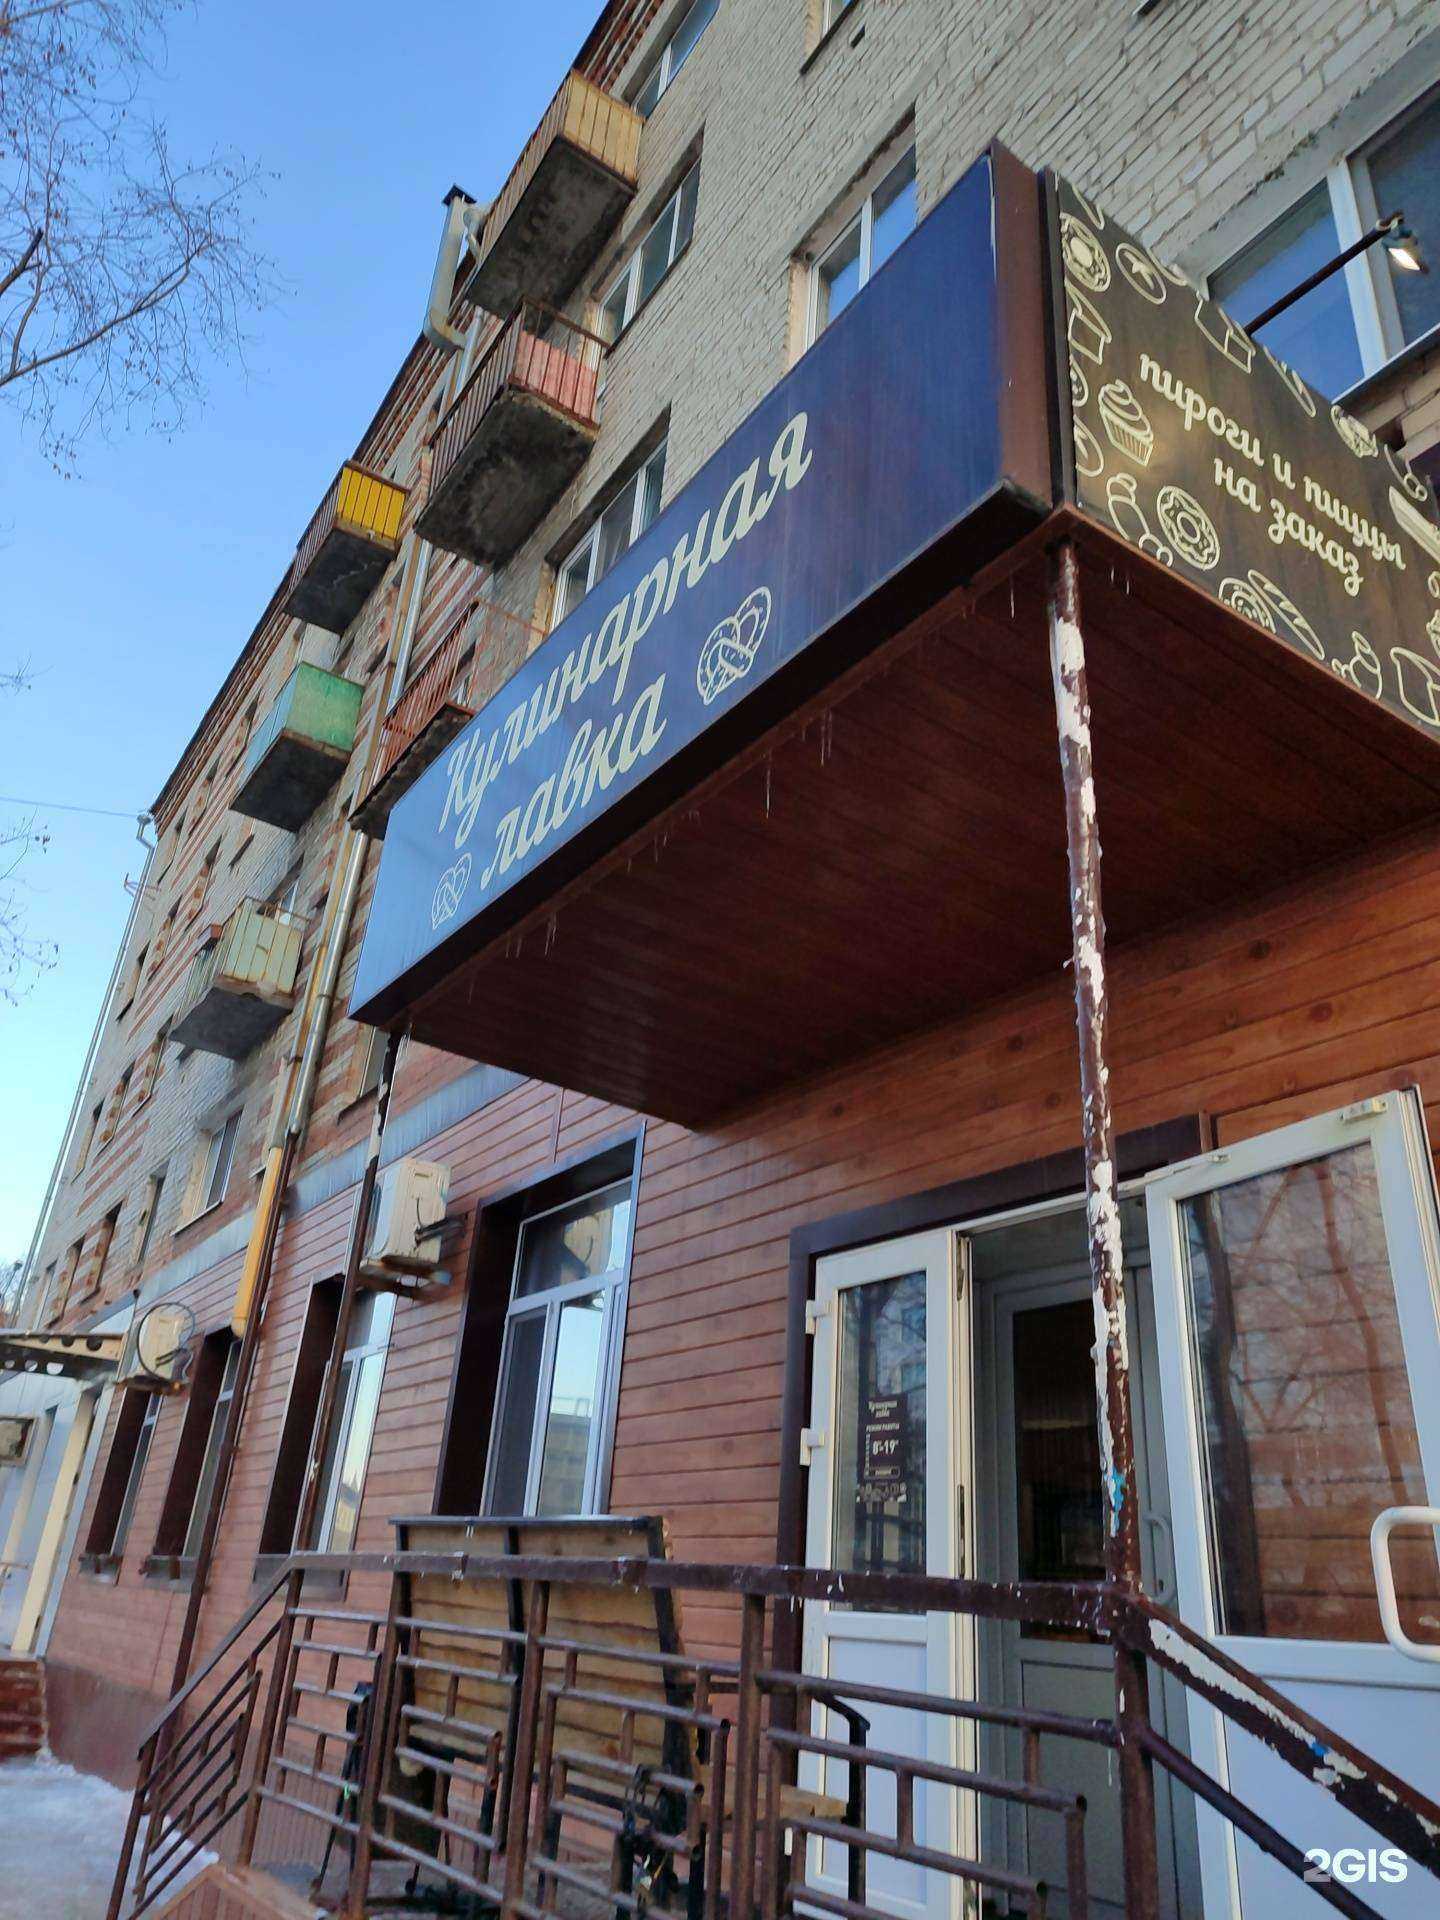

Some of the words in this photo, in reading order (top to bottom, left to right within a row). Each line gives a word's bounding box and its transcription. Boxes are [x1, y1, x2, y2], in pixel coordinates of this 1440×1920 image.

[1139, 353, 1265, 467] пироги
[1272, 452, 1296, 490] и
[1303, 475, 1406, 570] пиццы
[1214, 457, 1262, 513] на
[1268, 498, 1364, 597] заказ
[438, 411, 813, 849] Кулинарная
[481, 673, 667, 889] лавка
